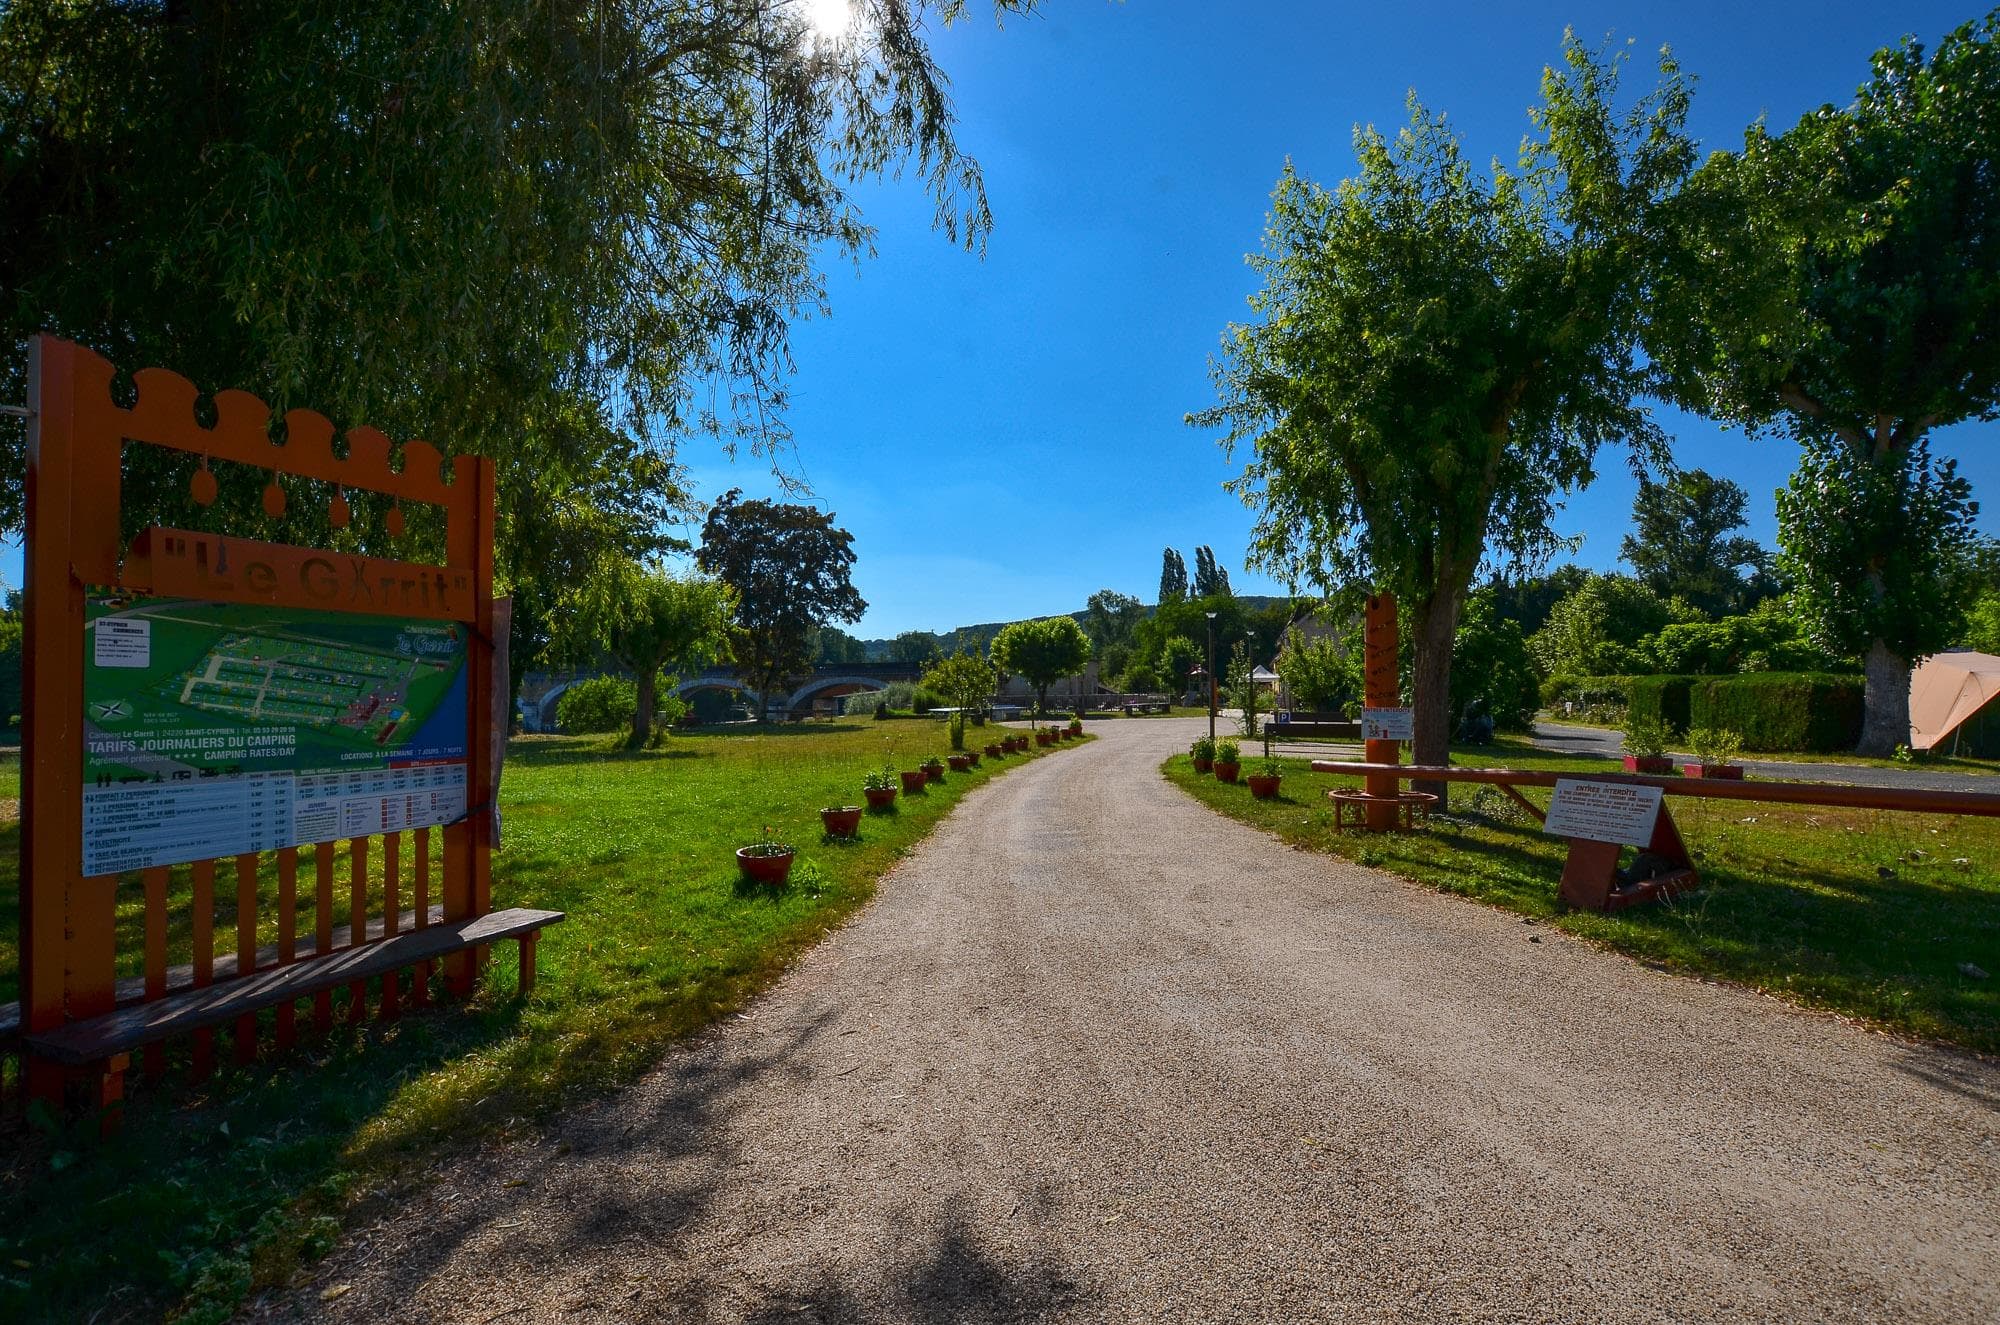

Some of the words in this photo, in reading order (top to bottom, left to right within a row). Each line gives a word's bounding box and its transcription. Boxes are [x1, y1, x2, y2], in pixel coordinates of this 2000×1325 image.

[88, 740, 136, 753] TARIFS
[140, 737, 225, 751] JOURNALIERS
[228, 736, 244, 747] DU
[247, 734, 296, 747] CAMPING
[204, 749, 247, 760] CAMPING
[249, 747, 296, 758] RATES/DAY
[340, 751, 373, 760] LOCATIONS
